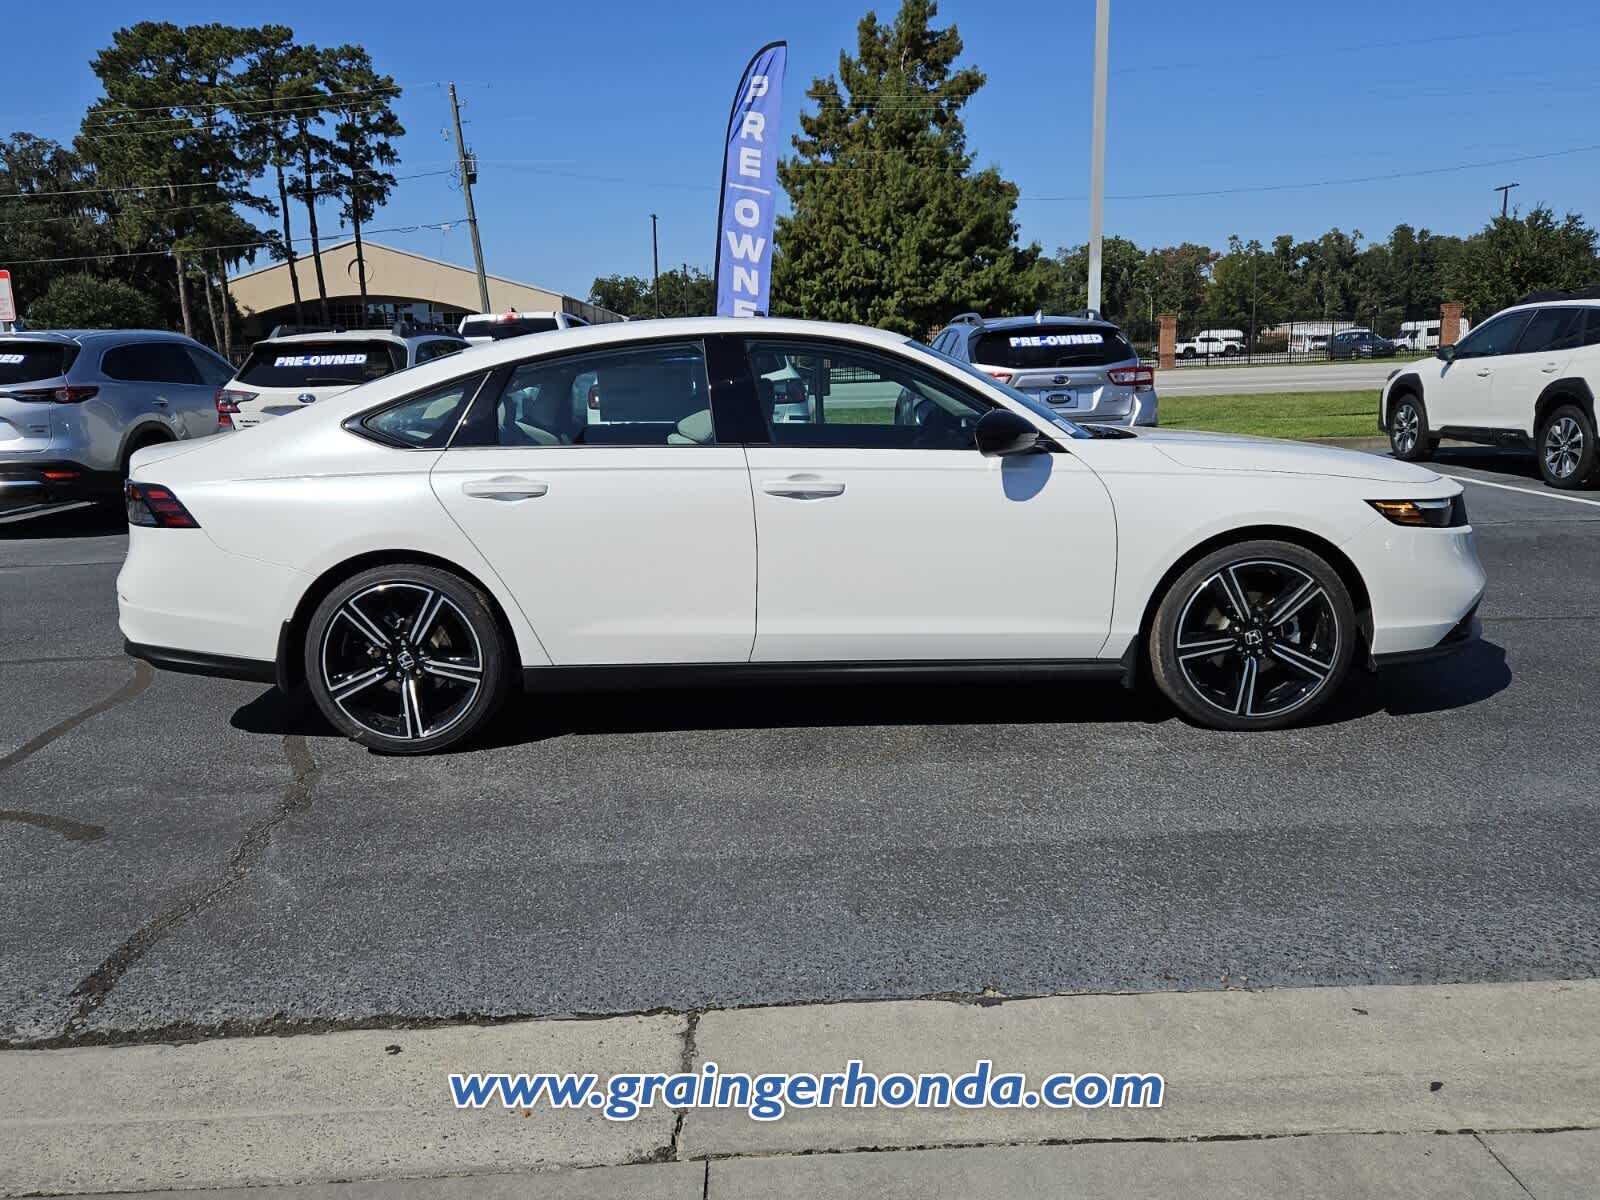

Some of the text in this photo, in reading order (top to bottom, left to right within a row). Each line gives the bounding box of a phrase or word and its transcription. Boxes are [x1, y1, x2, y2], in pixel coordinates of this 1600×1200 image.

[1009, 333, 1103, 347] PRE-OWNED
[0, 353, 25, 364] ED
[274, 353, 367, 367] PRE-OWNED
